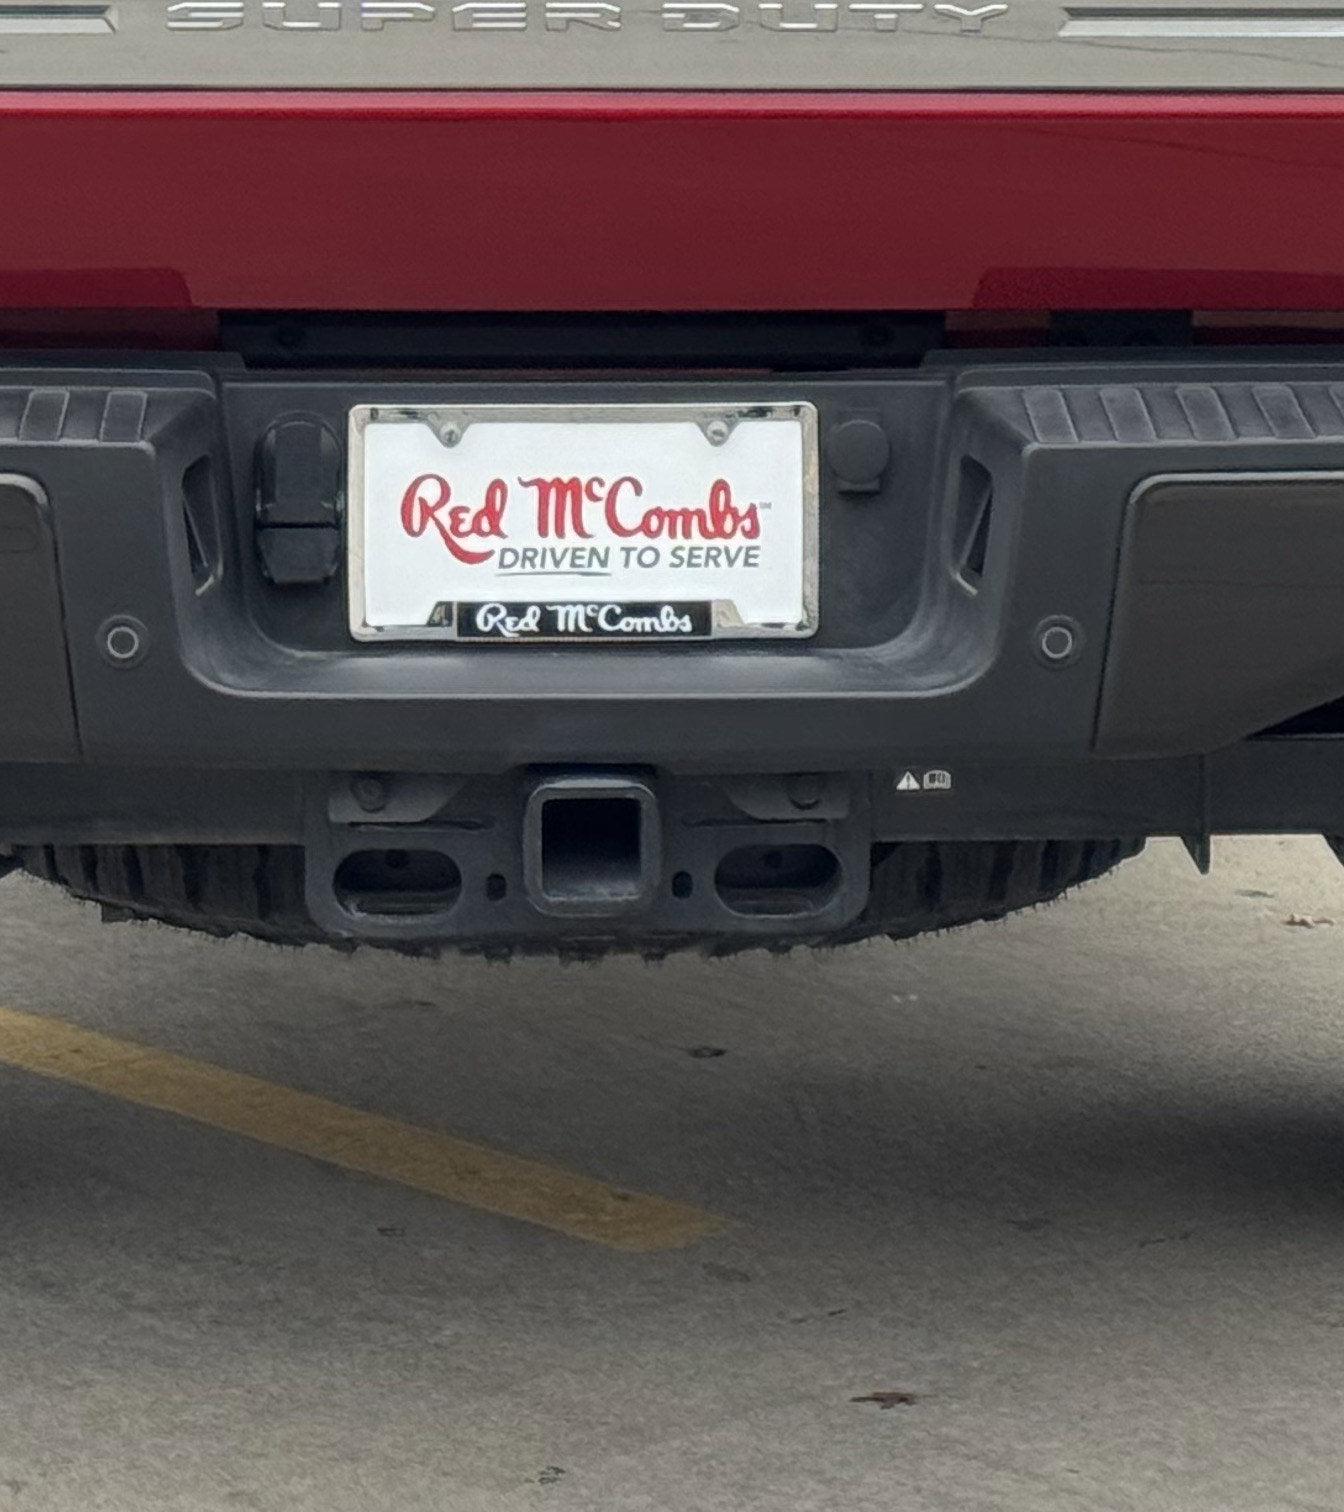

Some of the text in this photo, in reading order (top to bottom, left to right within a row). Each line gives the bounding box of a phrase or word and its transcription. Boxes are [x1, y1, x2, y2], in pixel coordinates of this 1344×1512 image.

[167, 1, 1009, 33] SUPER DUTY
[400, 473, 761, 565] Red McCombs
[497, 545, 761, 570] DRIVEN TO SERVE
[476, 603, 693, 637] Red McCombs
